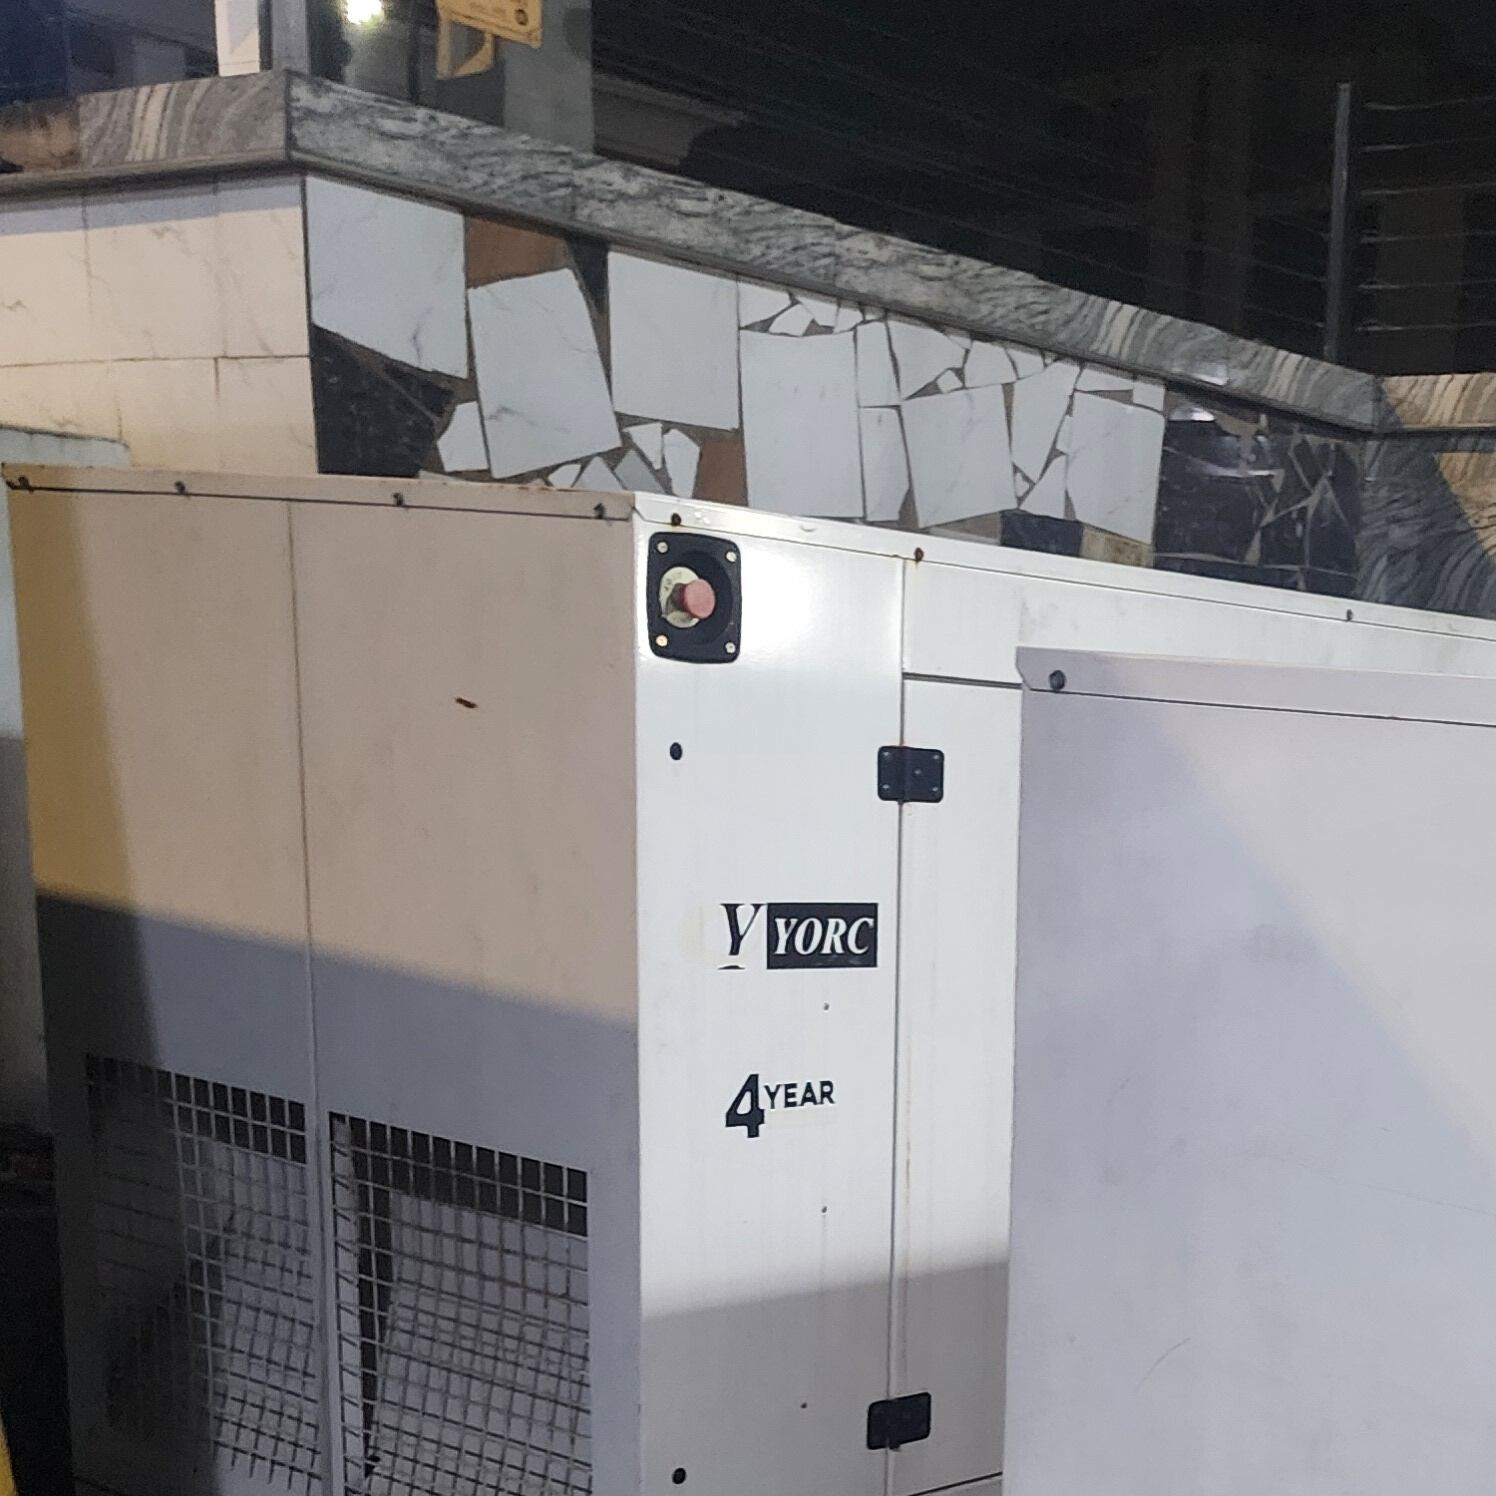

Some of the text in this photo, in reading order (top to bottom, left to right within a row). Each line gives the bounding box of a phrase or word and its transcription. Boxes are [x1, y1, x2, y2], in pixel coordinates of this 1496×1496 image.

[772, 914, 876, 957] YORC
[725, 1073, 835, 1138] 4 YEAR
